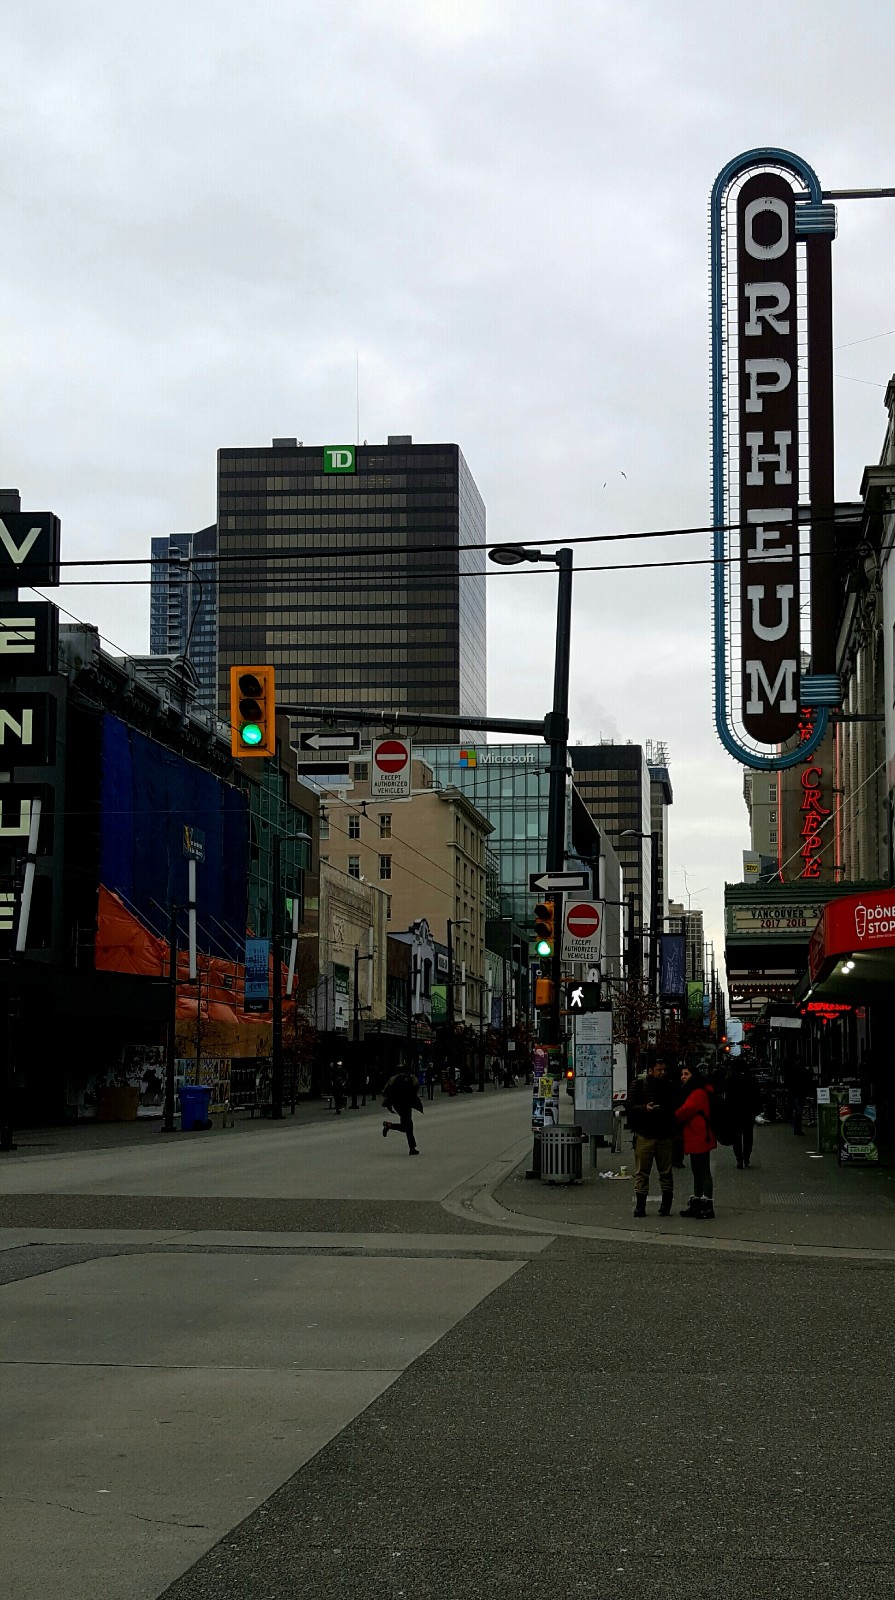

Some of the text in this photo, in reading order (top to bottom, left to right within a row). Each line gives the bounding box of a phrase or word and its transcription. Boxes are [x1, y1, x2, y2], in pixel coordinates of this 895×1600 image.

[325, 449, 354, 469] TD
[744, 195, 798, 715] ORPHEUM
[479, 752, 536, 764] Microsoft
[751, 909, 804, 919] VANCOUVER
[760, 918, 807, 928] 2017 2018
[868, 920, 895, 933] STOP
